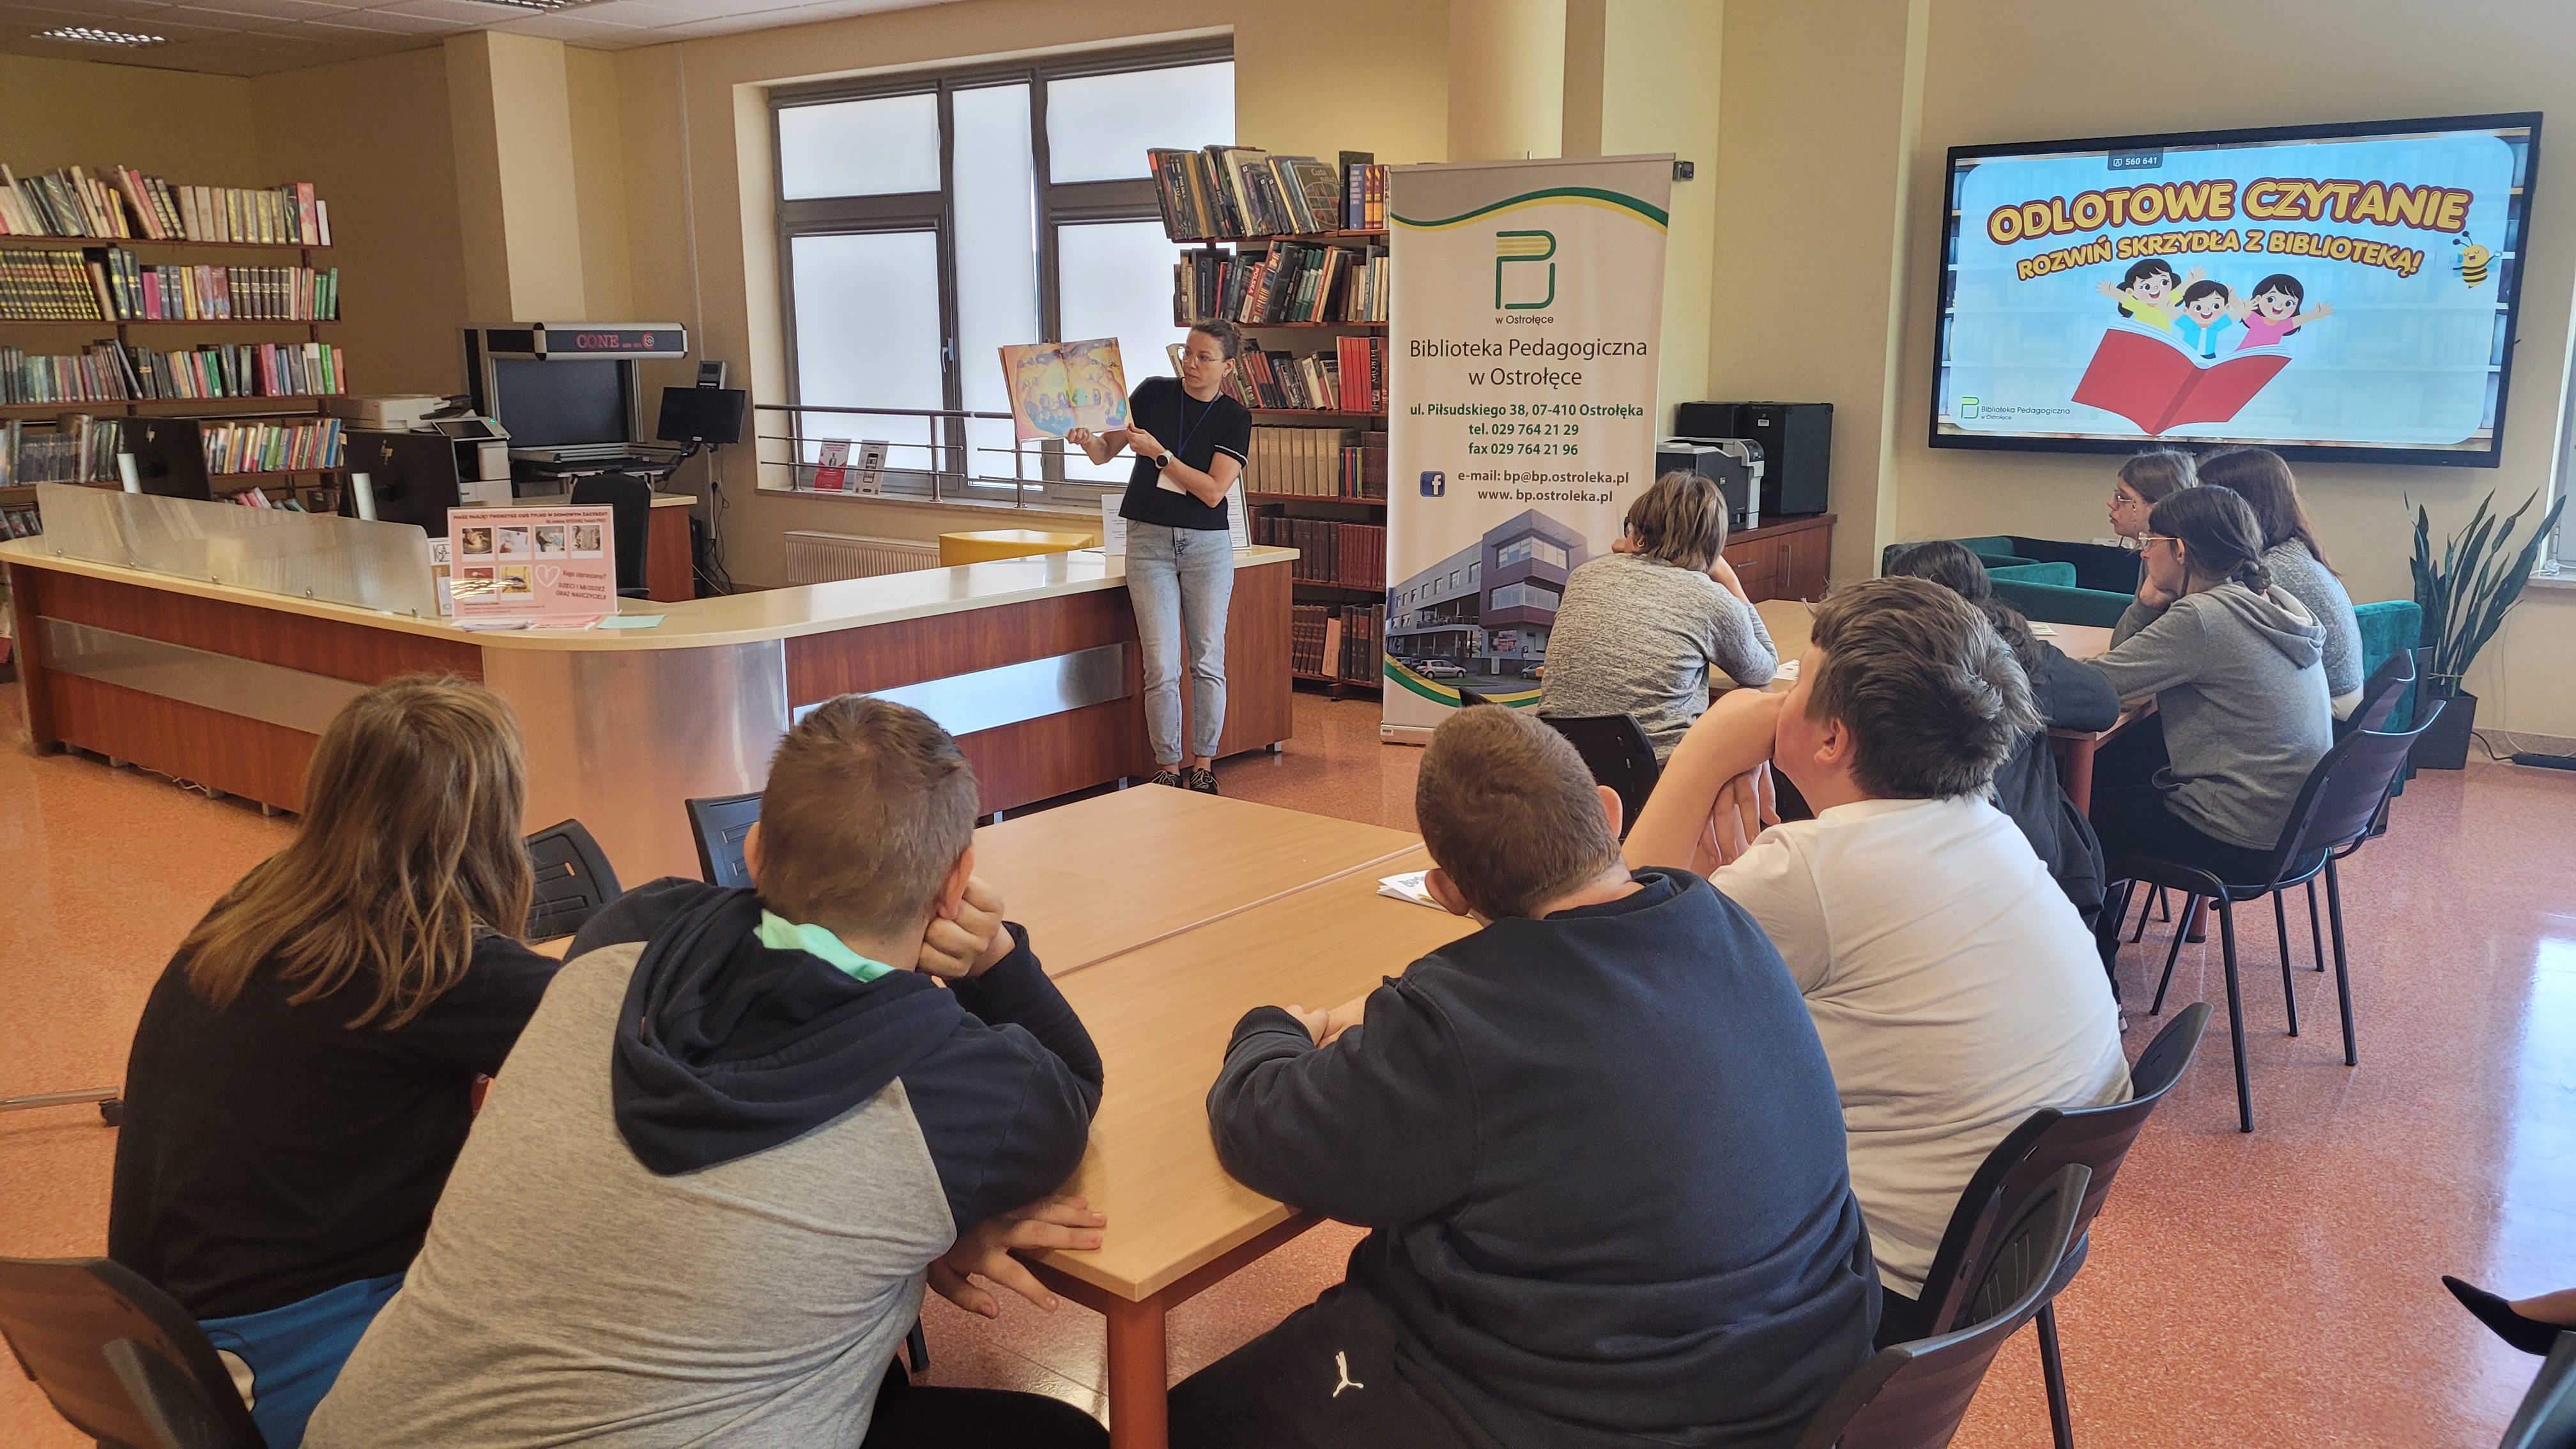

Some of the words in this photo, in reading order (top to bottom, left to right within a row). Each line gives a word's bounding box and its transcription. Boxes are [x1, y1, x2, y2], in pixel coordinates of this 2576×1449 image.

[1988, 180, 2236, 244] ODLOTOWE
[2243, 179, 2472, 231] CZYTANIE
[2017, 235, 2112, 280] ROZWIŃ
[2117, 230, 2239, 259] SKRZYDŁA
[2244, 230, 2264, 252] Z
[2269, 231, 2424, 277] BIBLIOTEKĄ!
[1248, 267, 1259, 294] POLSKA
[1506, 315, 1554, 325] Ostrołęce
[576, 334, 619, 349] CONE
[1411, 339, 1501, 356] Biblioteka
[1510, 338, 1646, 360] Pedagogiczna
[1469, 373, 1485, 385] w
[1491, 367, 1581, 390] Ostrołęce
[1411, 403, 1424, 415] ul.
[1428, 403, 1506, 418] Piłsudskiego
[1510, 404, 1528, 417] 38,
[1533, 404, 1575, 415] 07-410
[1580, 404, 1643, 419] Ostrołęka
[1469, 423, 1488, 434] tel.
[1492, 424, 1514, 434] 029
[1519, 424, 1541, 434] 764
[1544, 424, 1558, 435] 21
[1563, 424, 1579, 435] 29
[1469, 442, 1488, 454] fax
[1491, 443, 1514, 454] 029
[1518, 444, 1540, 454] 764
[1544, 444, 1557, 455] 21
[1563, 444, 1577, 455] 96
[1459, 470, 1500, 480] e-mail:
[1504, 470, 1629, 486] bp@bp.ostroleka.pl
[1478, 491, 1512, 500] www.
[1517, 489, 1612, 504] bp.ostroleka.pl
